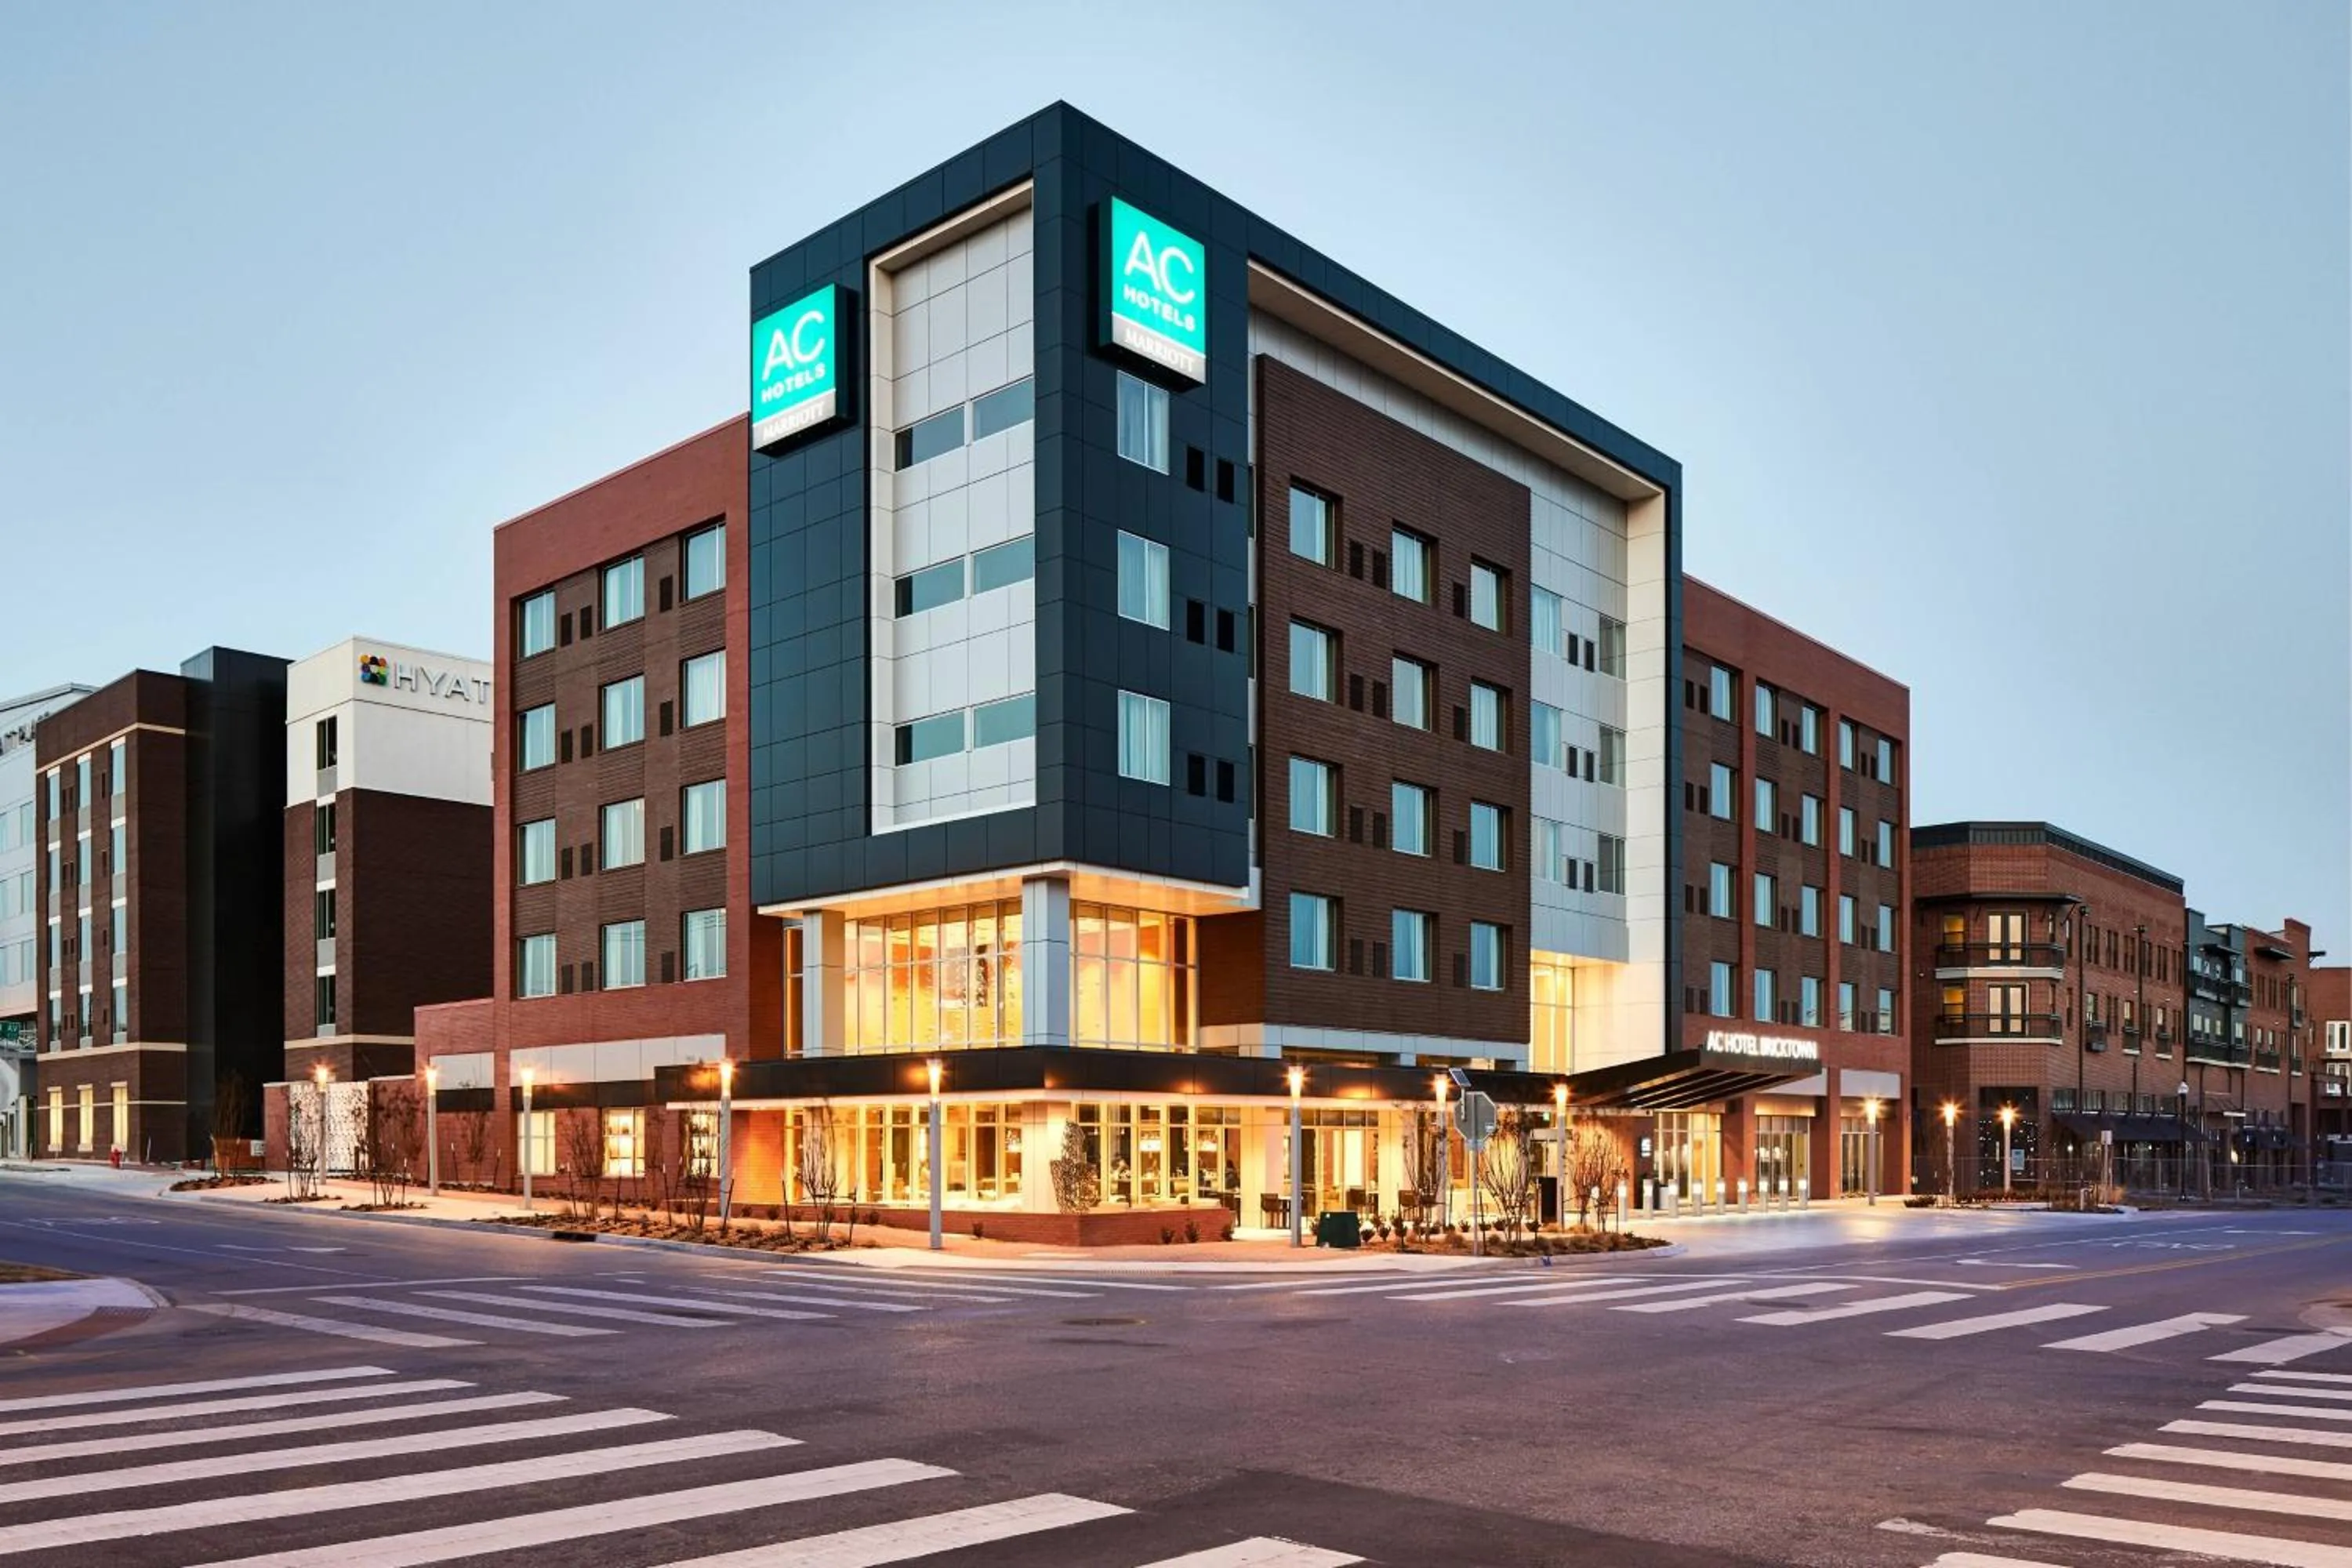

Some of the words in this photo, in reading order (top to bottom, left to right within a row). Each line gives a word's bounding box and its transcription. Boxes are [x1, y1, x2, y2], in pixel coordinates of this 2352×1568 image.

[1123, 230, 1195, 304] AC
[1123, 283, 1196, 332] HOTELS
[761, 310, 825, 382] AC
[1124, 328, 1195, 373] MARRIOTT
[760, 362, 826, 404] HOTELS
[762, 401, 826, 441] MARRIOTT
[1707, 1030, 1724, 1052] AC
[1725, 1033, 1759, 1056] HOTEL
[1760, 1036, 1818, 1060] BRICKTOWN
